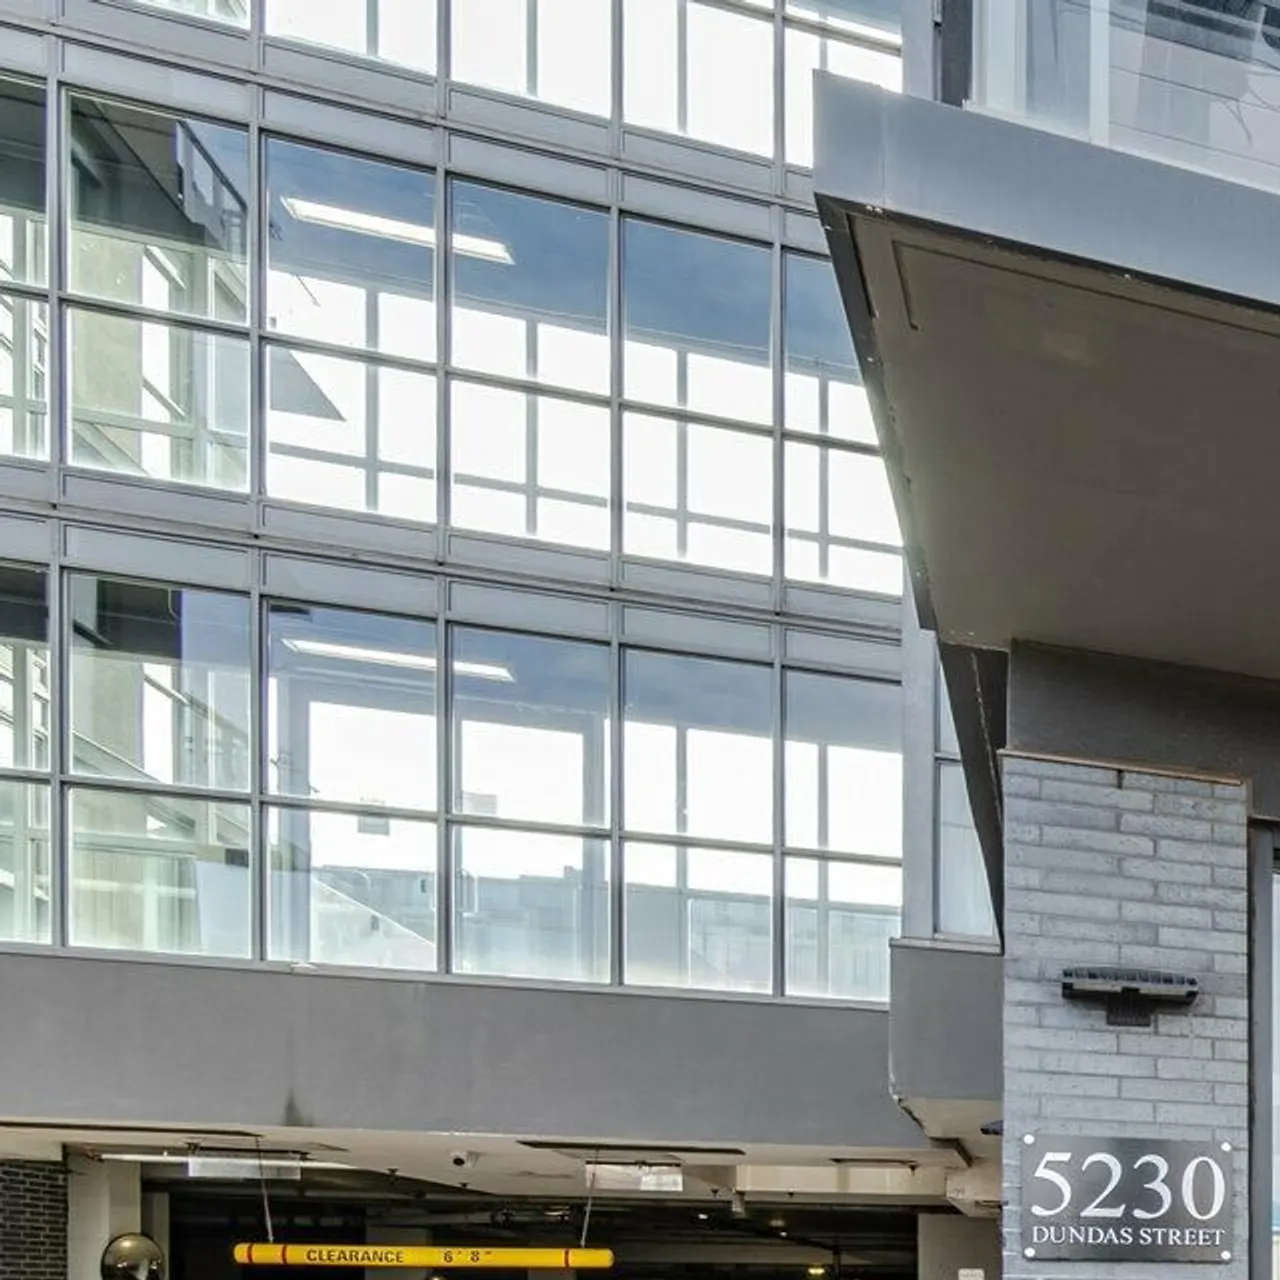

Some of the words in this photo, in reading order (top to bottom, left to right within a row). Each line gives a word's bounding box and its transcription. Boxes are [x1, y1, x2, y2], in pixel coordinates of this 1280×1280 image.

[1030, 1151, 1226, 1220] 5230
[1032, 1226, 1134, 1245] DUNDAS
[1139, 1228, 1226, 1246] STREET
[305, 1248, 404, 1264] CLEARANCE
